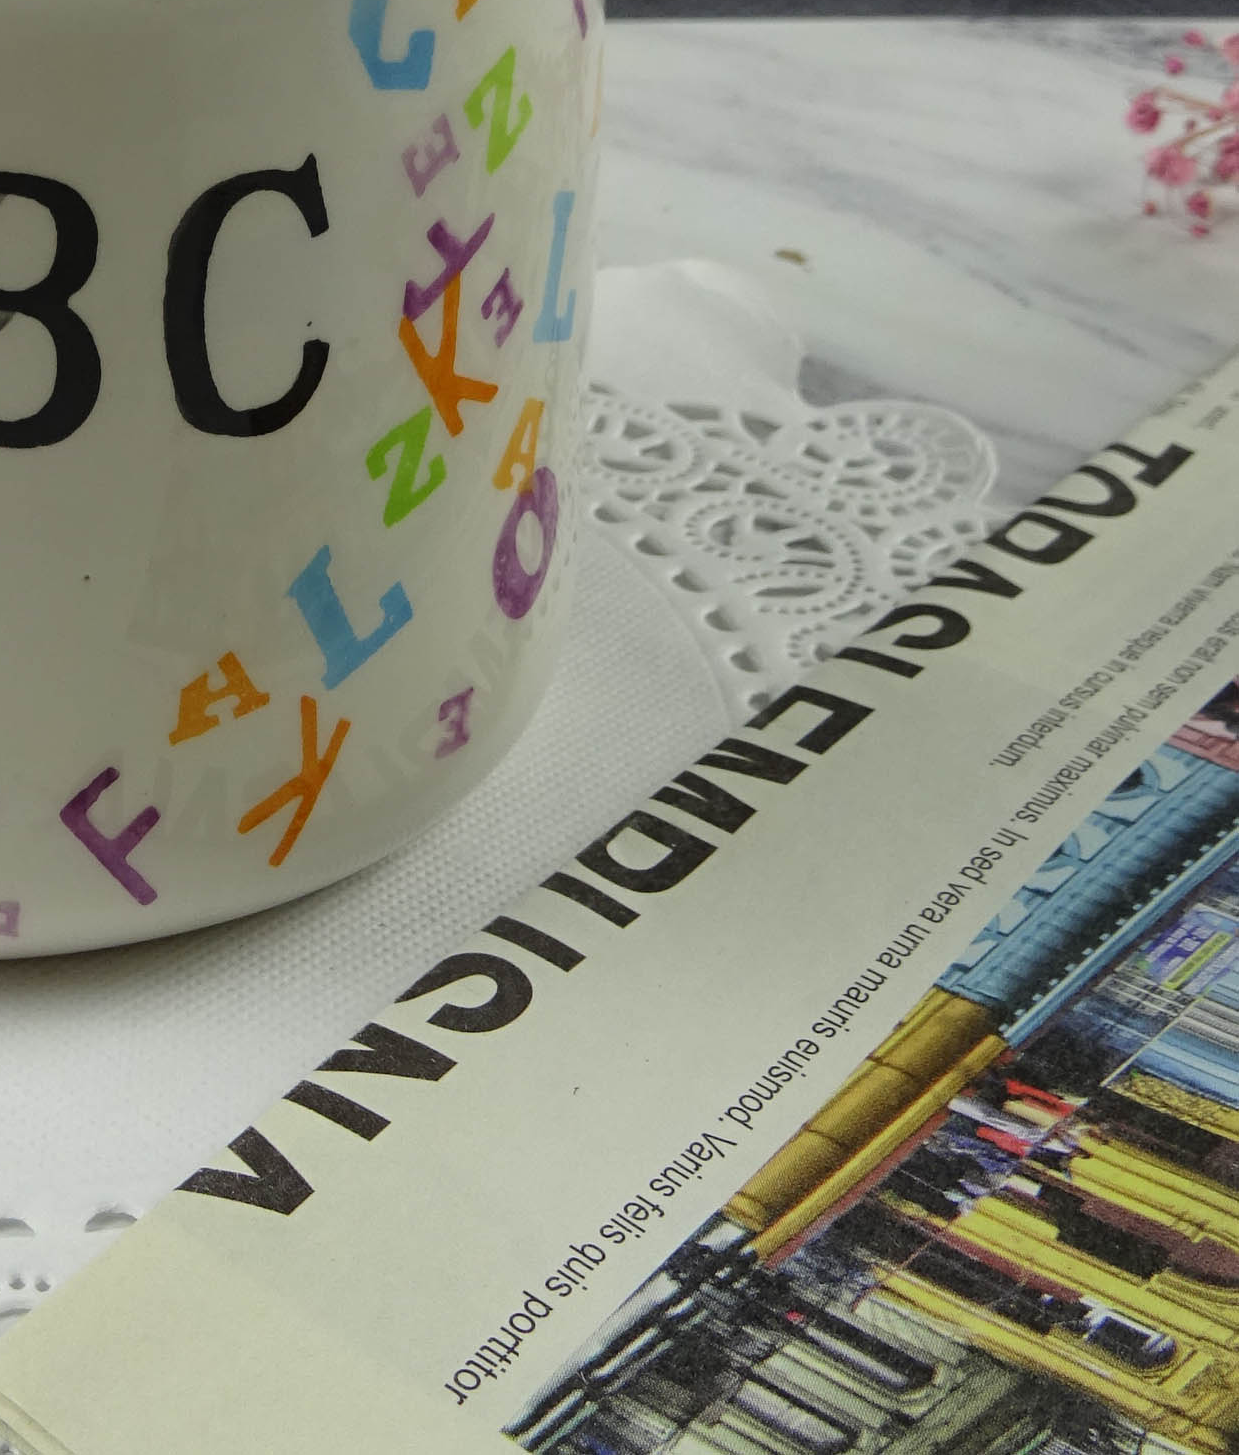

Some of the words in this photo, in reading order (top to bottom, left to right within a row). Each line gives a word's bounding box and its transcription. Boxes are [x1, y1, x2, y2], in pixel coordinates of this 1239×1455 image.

[463, 45, 534, 176] Z
[532, 190, 576, 343] L
[364, 405, 448, 530] Z
[491, 397, 545, 497] A
[491, 466, 560, 621] O
[286, 545, 414, 691] L
[988, 707, 1069, 768] interdum.
[1009, 755, 1093, 824] maximus.
[59, 766, 161, 906] F
[958, 846, 1003, 885] sed
[990, 827, 1029, 847] In
[918, 882, 973, 924] vera
[875, 923, 931, 969] urna
[811, 968, 888, 1038] mauris
[718, 1038, 820, 1131] euismod.
[649, 1132, 738, 1197] Varius
[599, 1194, 665, 1244] felis
[544, 1243, 606, 1298] quis
[444, 1290, 554, 1406] porttitor
